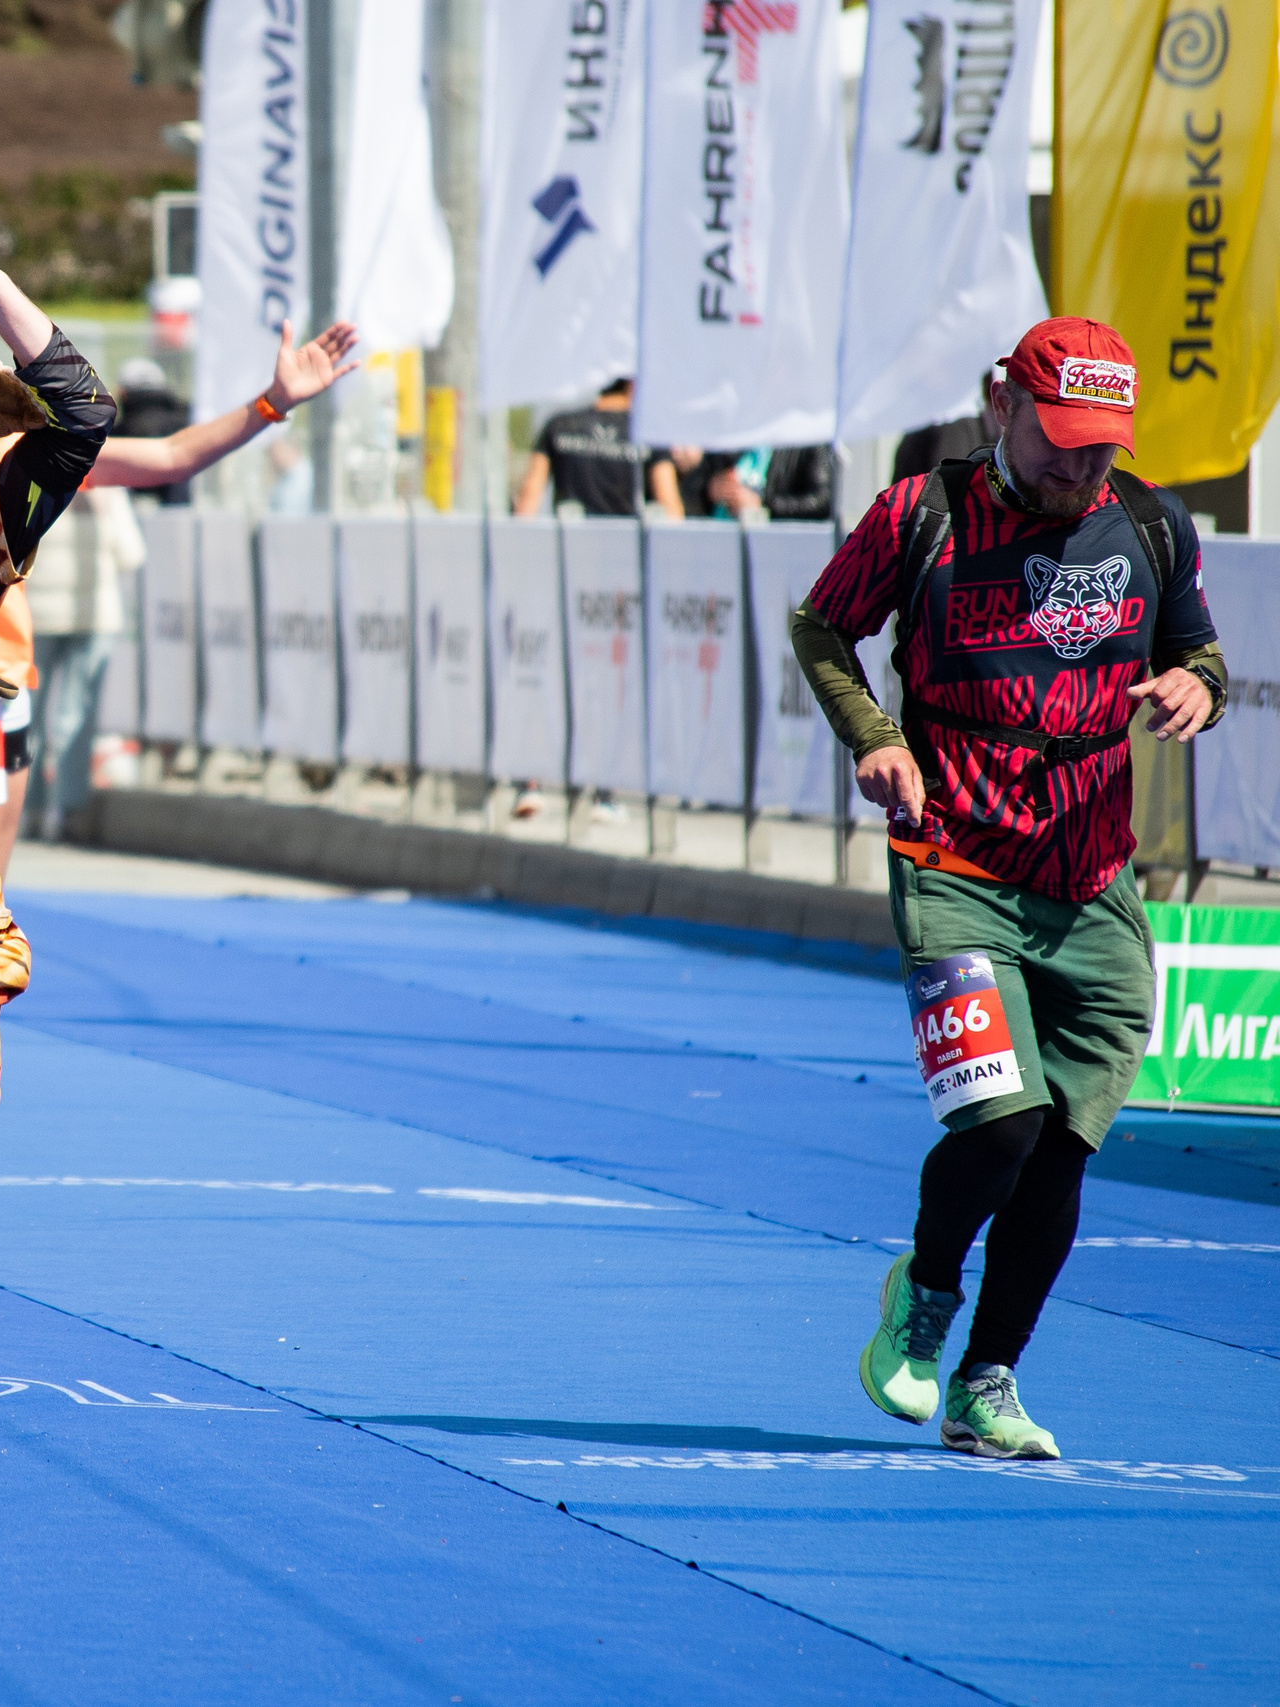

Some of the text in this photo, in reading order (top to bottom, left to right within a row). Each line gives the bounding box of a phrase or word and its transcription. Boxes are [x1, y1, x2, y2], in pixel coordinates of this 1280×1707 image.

[1169, 109, 1228, 383] Яндекс
[948, 585, 1019, 619] RUN
[919, 999, 990, 1052] 1466
[937, 1047, 963, 1065] ПАВЕЛ
